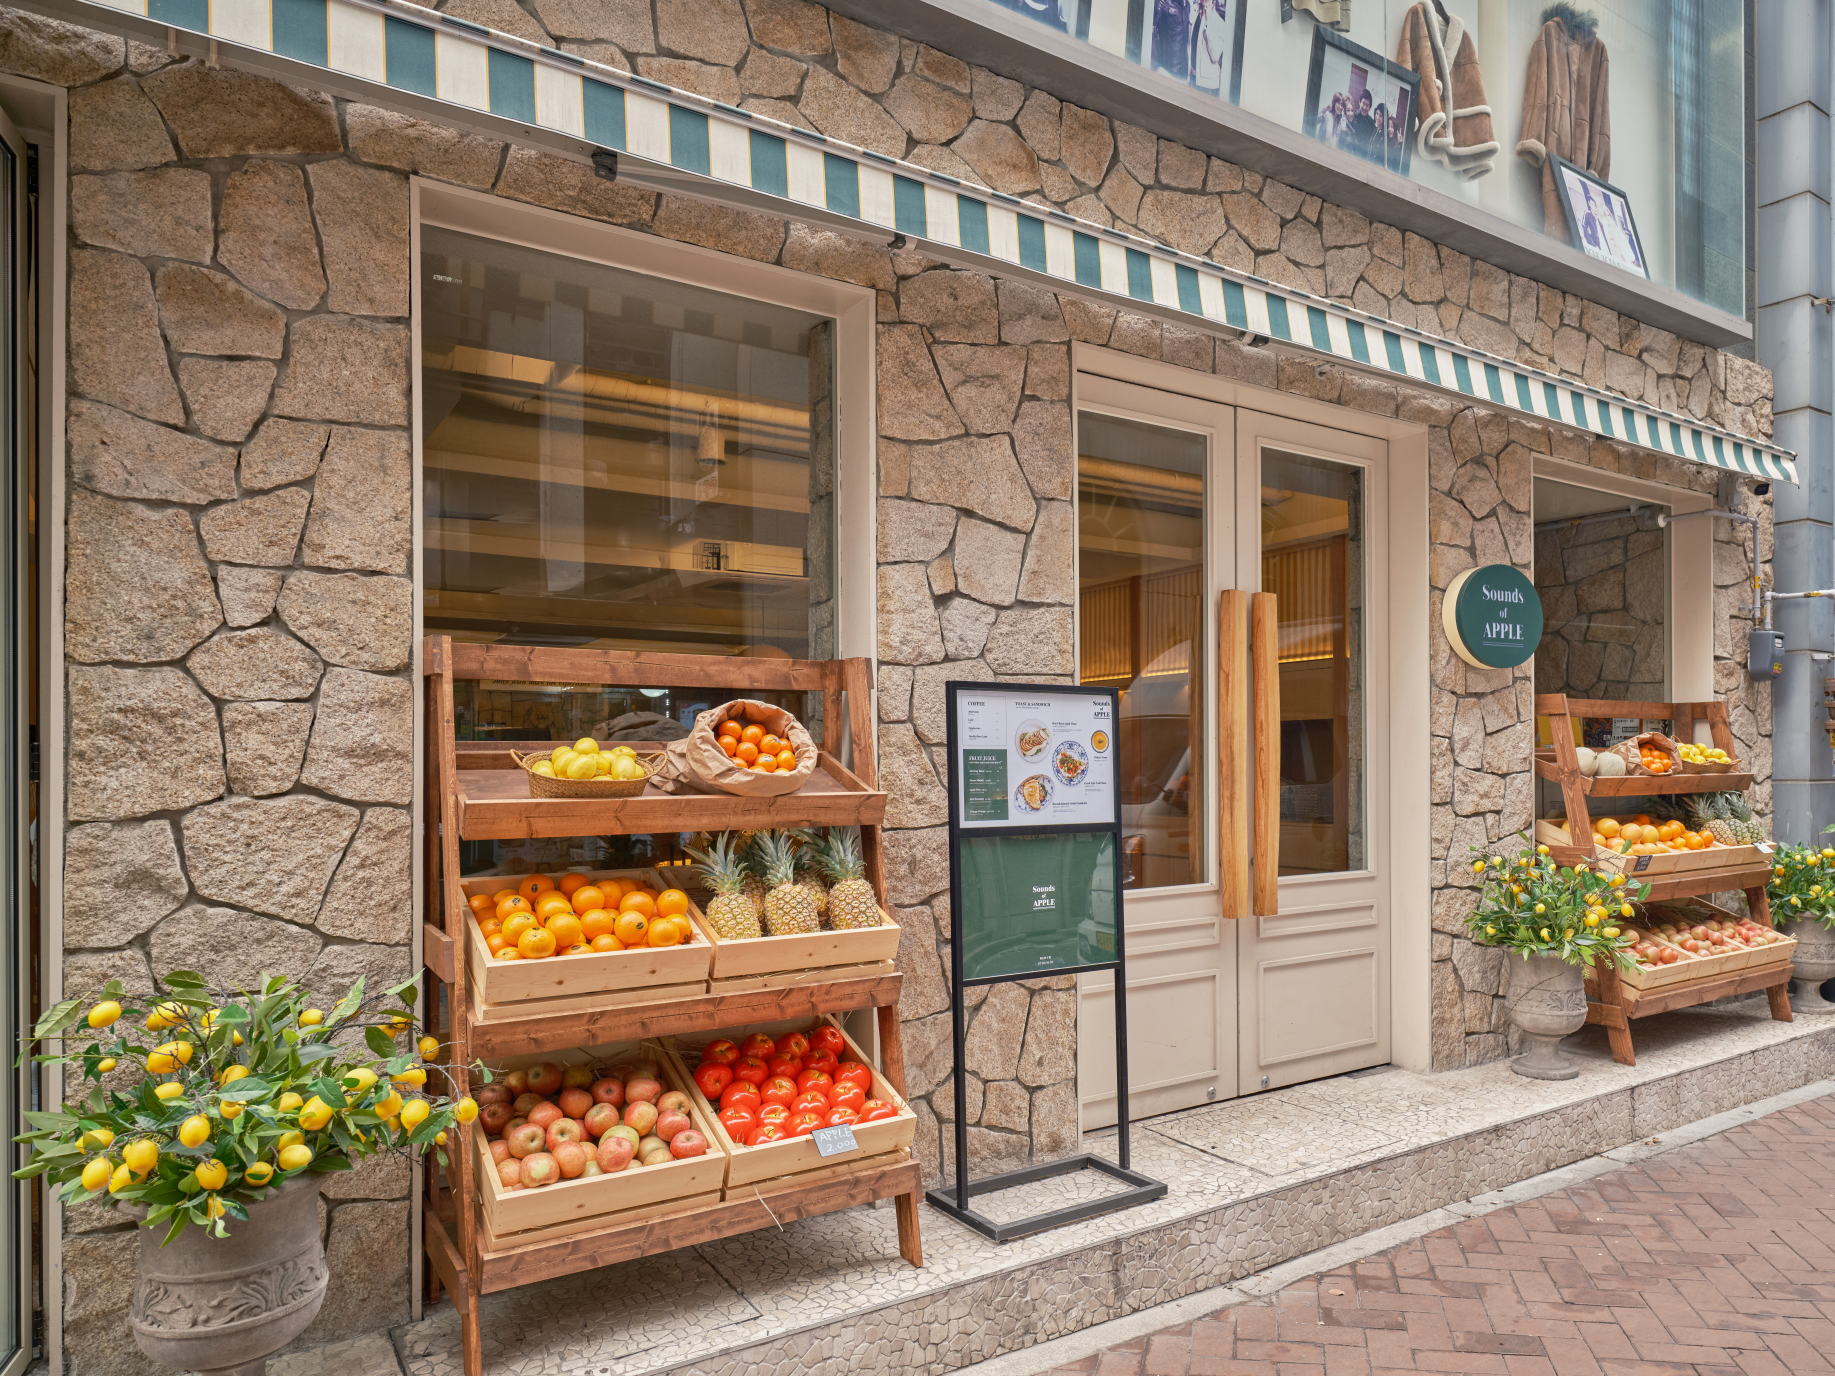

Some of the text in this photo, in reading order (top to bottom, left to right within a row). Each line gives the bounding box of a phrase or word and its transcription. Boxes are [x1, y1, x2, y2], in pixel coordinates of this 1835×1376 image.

[1482, 584, 1524, 604] Sounds
[1499, 607, 1508, 618] of
[1482, 622, 1524, 640] APPLE
[1032, 885, 1056, 893] Sounds
[1033, 898, 1056, 907] APPLE
[820, 1127, 852, 1142] APPLE
